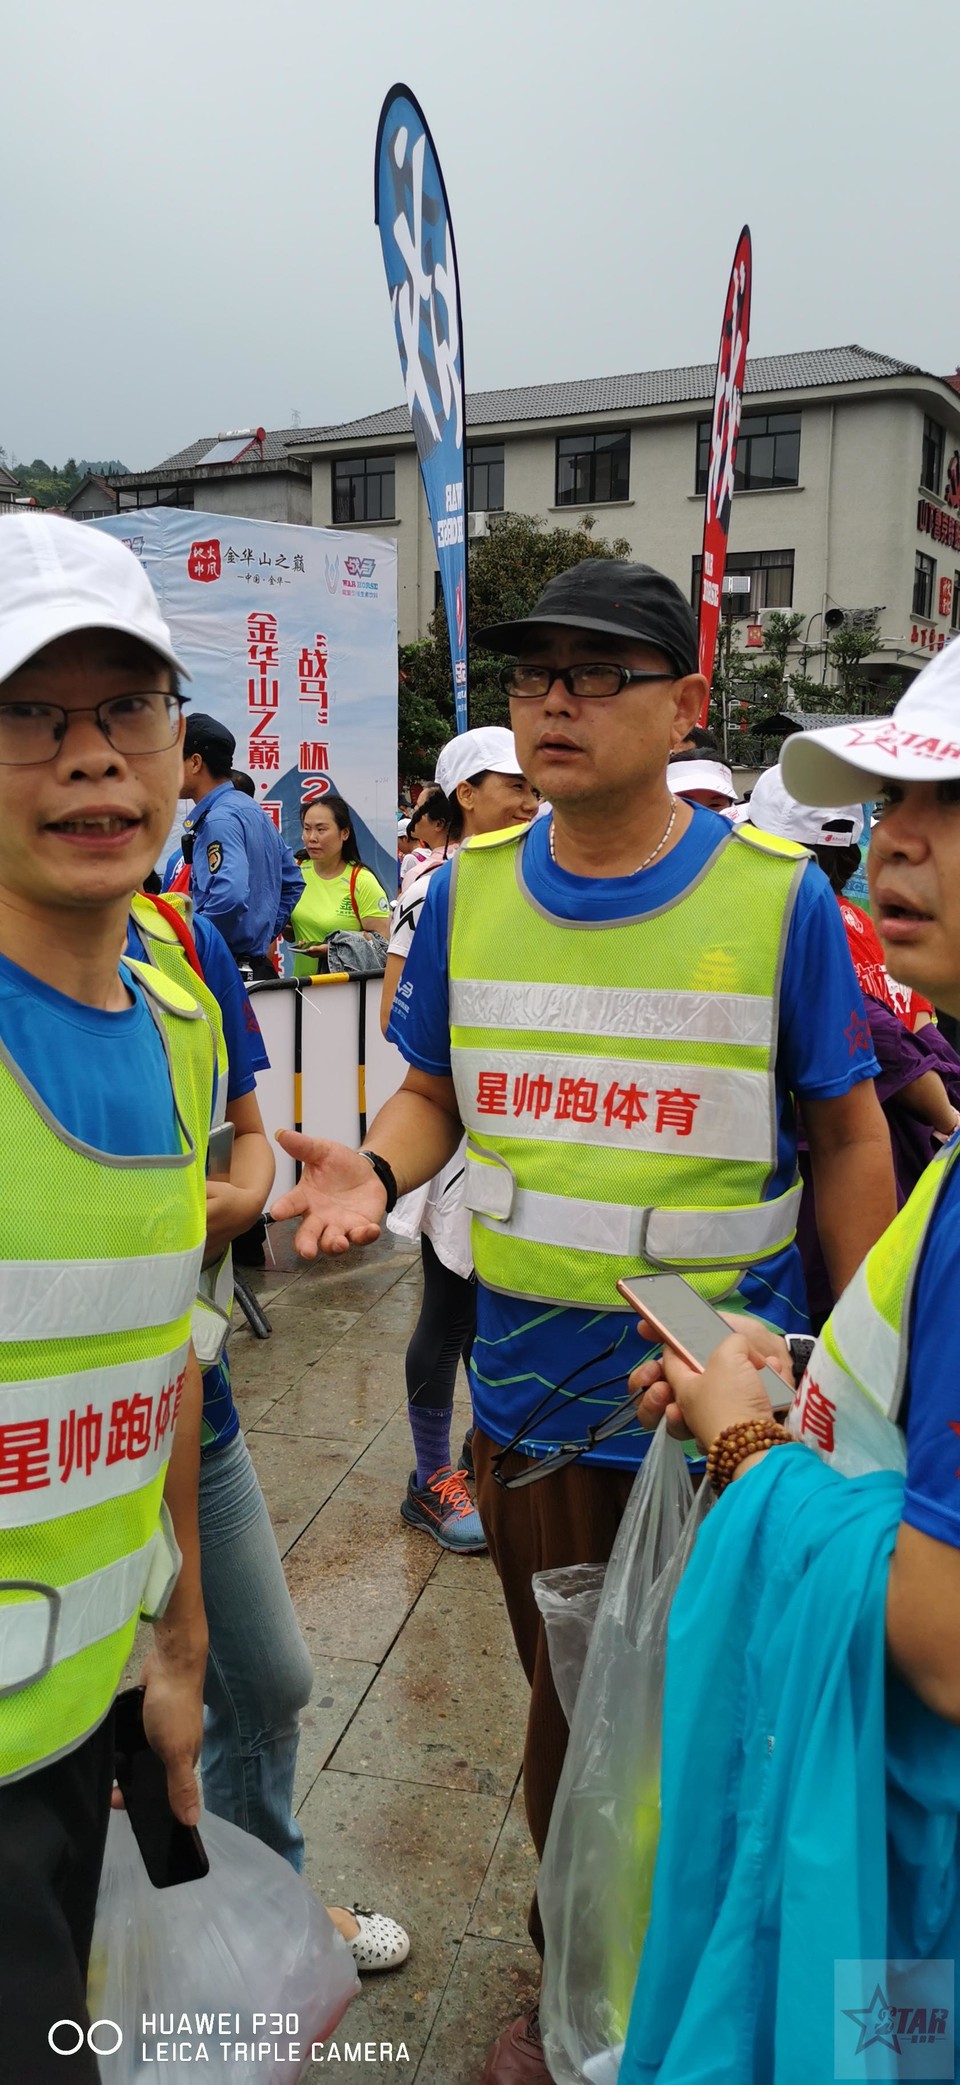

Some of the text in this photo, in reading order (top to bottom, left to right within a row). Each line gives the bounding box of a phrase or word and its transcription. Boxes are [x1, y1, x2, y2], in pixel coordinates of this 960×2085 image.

[224, 546, 305, 573] 金华山之巅
[342, 580, 378, 590] WAR HORSE
[475, 1071, 701, 1137] 星帅跑体育
